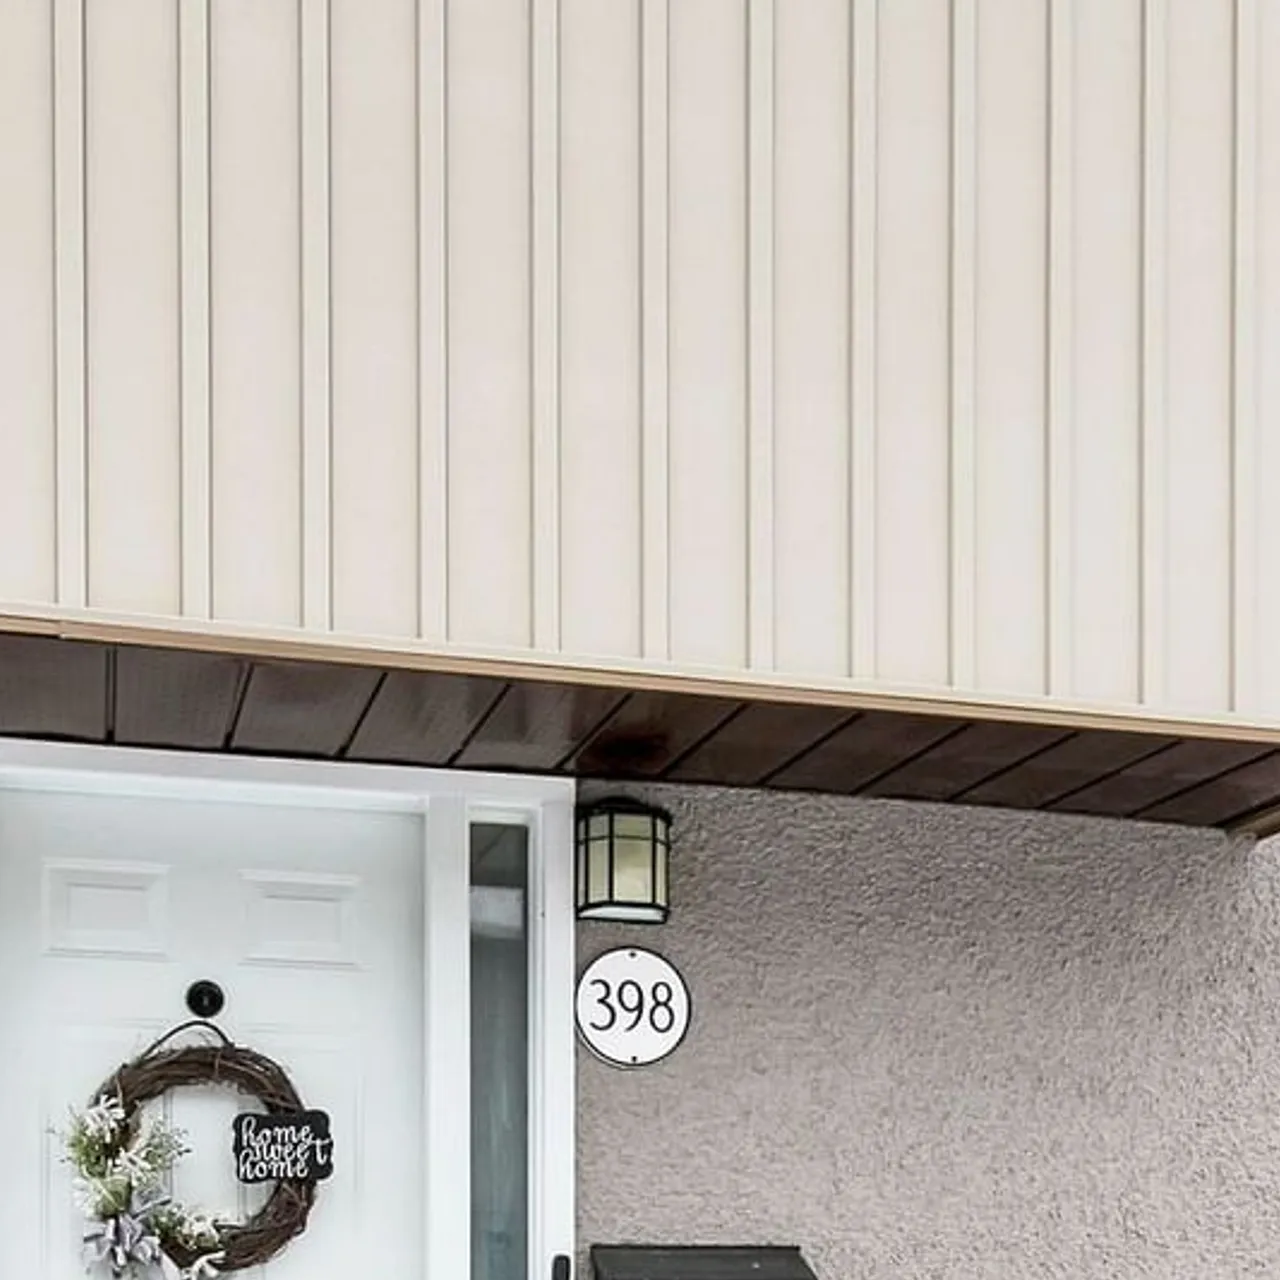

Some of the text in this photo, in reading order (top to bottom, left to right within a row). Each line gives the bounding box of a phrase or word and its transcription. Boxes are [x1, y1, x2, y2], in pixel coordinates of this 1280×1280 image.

[589, 979, 675, 1033] 398
[241, 1116, 314, 1148] home
[239, 1147, 308, 1179] home
[252, 1138, 332, 1165] sweet
